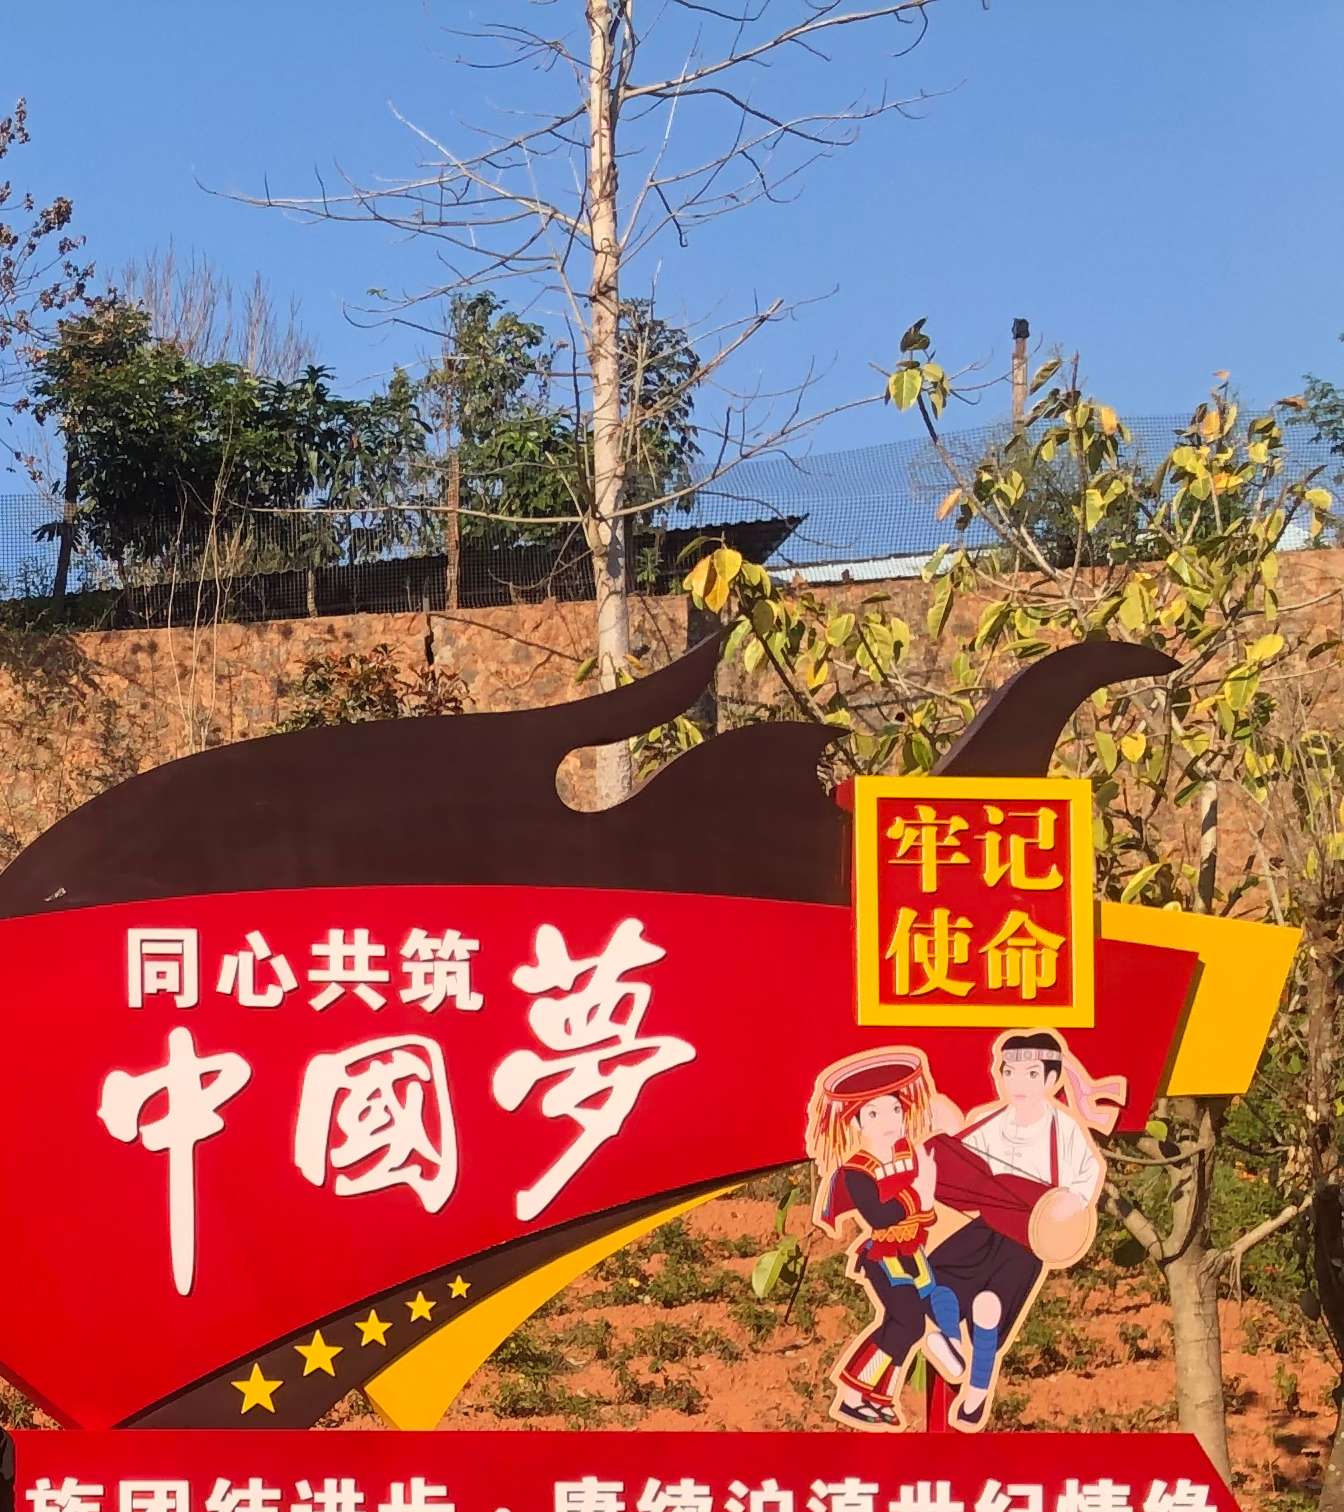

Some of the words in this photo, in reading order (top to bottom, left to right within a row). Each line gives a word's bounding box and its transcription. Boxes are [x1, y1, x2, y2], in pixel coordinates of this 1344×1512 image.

[886, 805, 1064, 893] 牢记
[127, 927, 484, 1013] 同心共筑
[885, 907, 1066, 1000] 使命
[97, 918, 696, 1297] 中國夢
